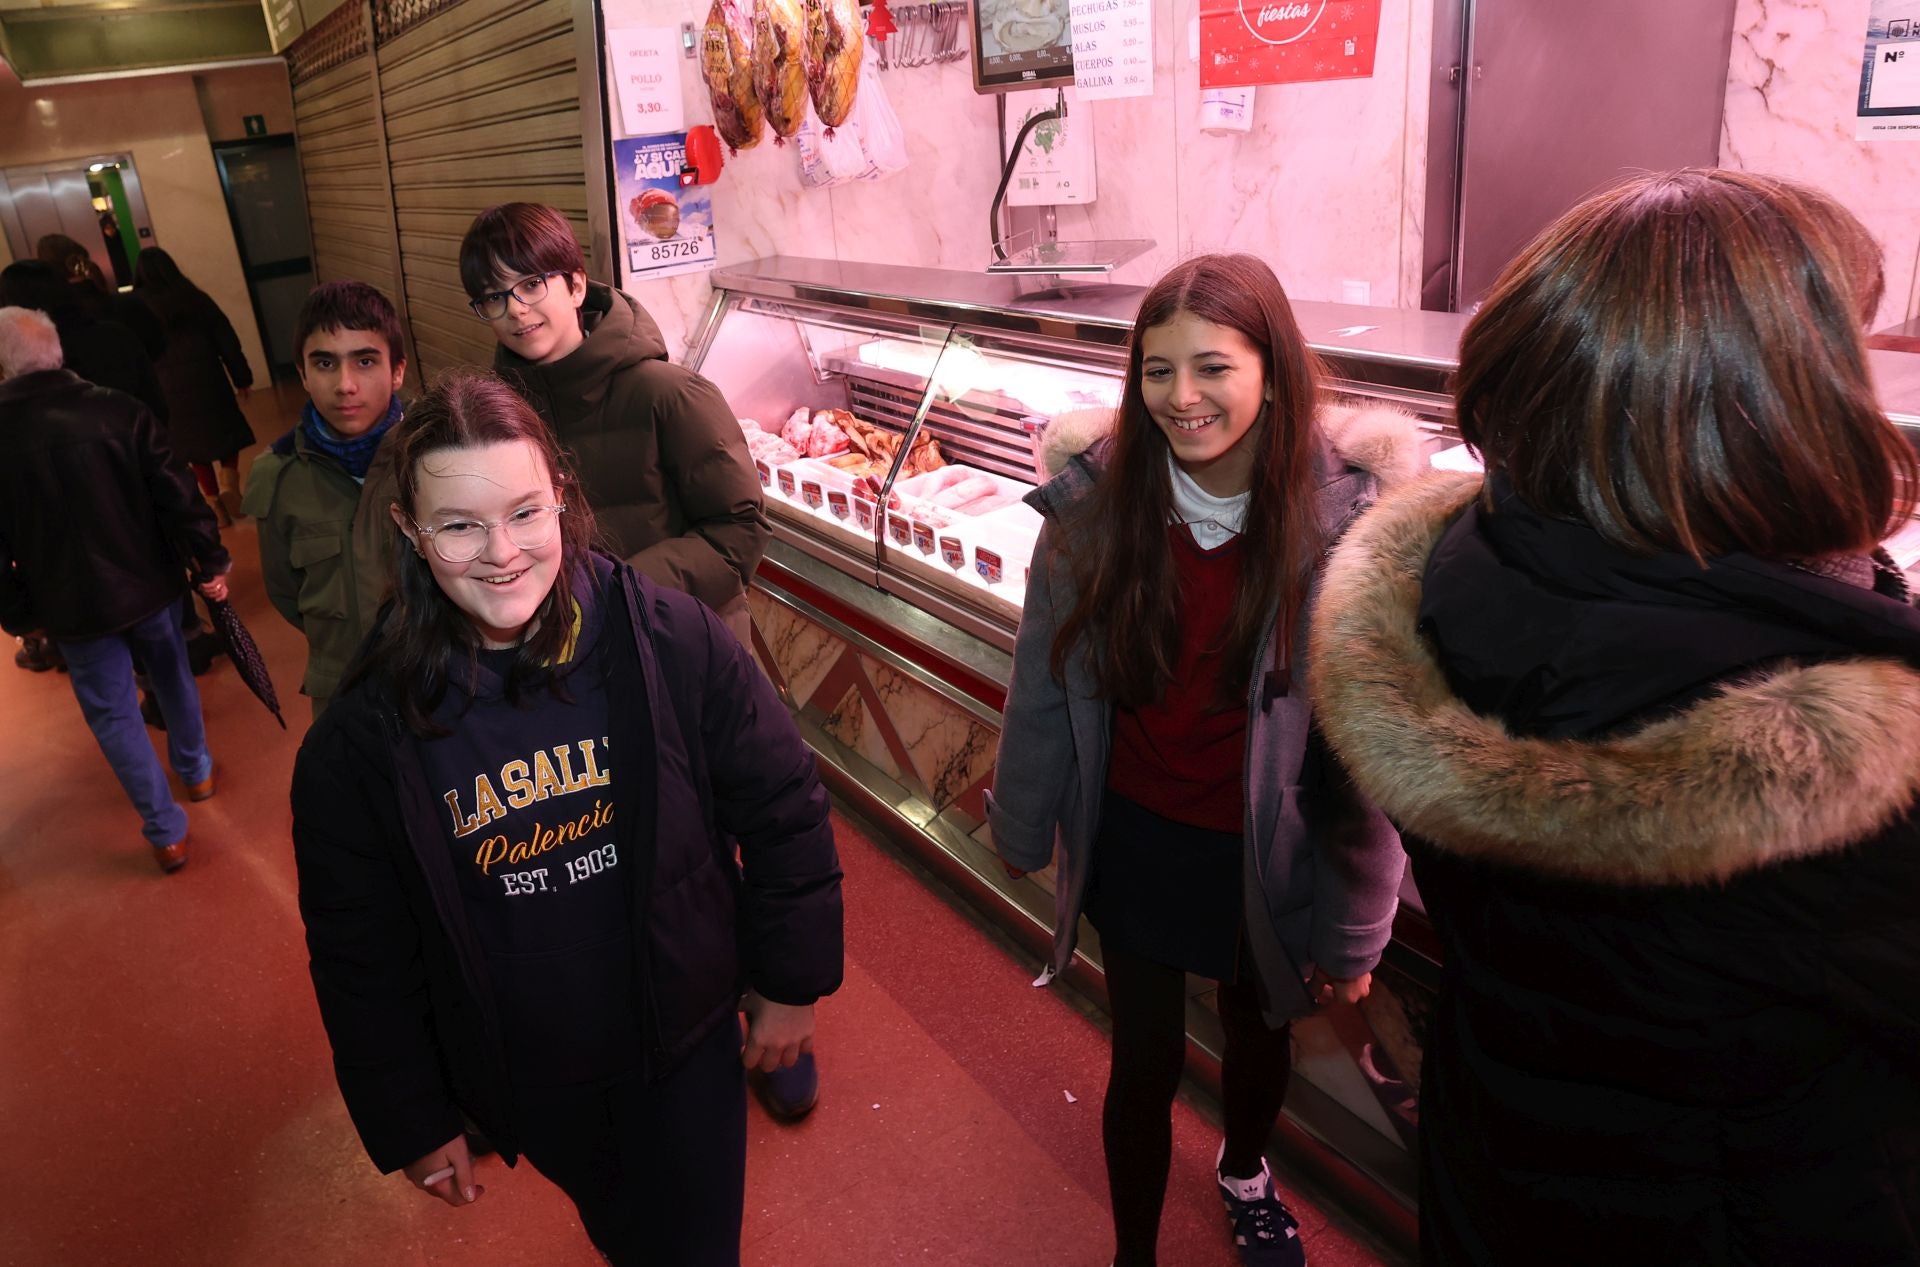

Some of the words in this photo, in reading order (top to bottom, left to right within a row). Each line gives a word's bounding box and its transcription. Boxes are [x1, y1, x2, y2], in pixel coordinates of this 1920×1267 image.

[1071, 0, 1119, 17] PECHUGAS
[1256, 2, 1311, 28] fiestas
[1072, 20, 1106, 35] MUSLOS
[629, 48, 660, 58] OFERTA
[1074, 40, 1097, 54] ALAS
[1075, 56, 1114, 72] CUERPOS
[631, 74, 662, 84] POLLO
[1076, 75, 1114, 89] GALLINA
[637, 102, 662, 114] 3,30
[650, 151, 663, 162] SI
[651, 240, 699, 260] 85726
[500, 868, 557, 896] EST.
[565, 843, 618, 885] 1903
